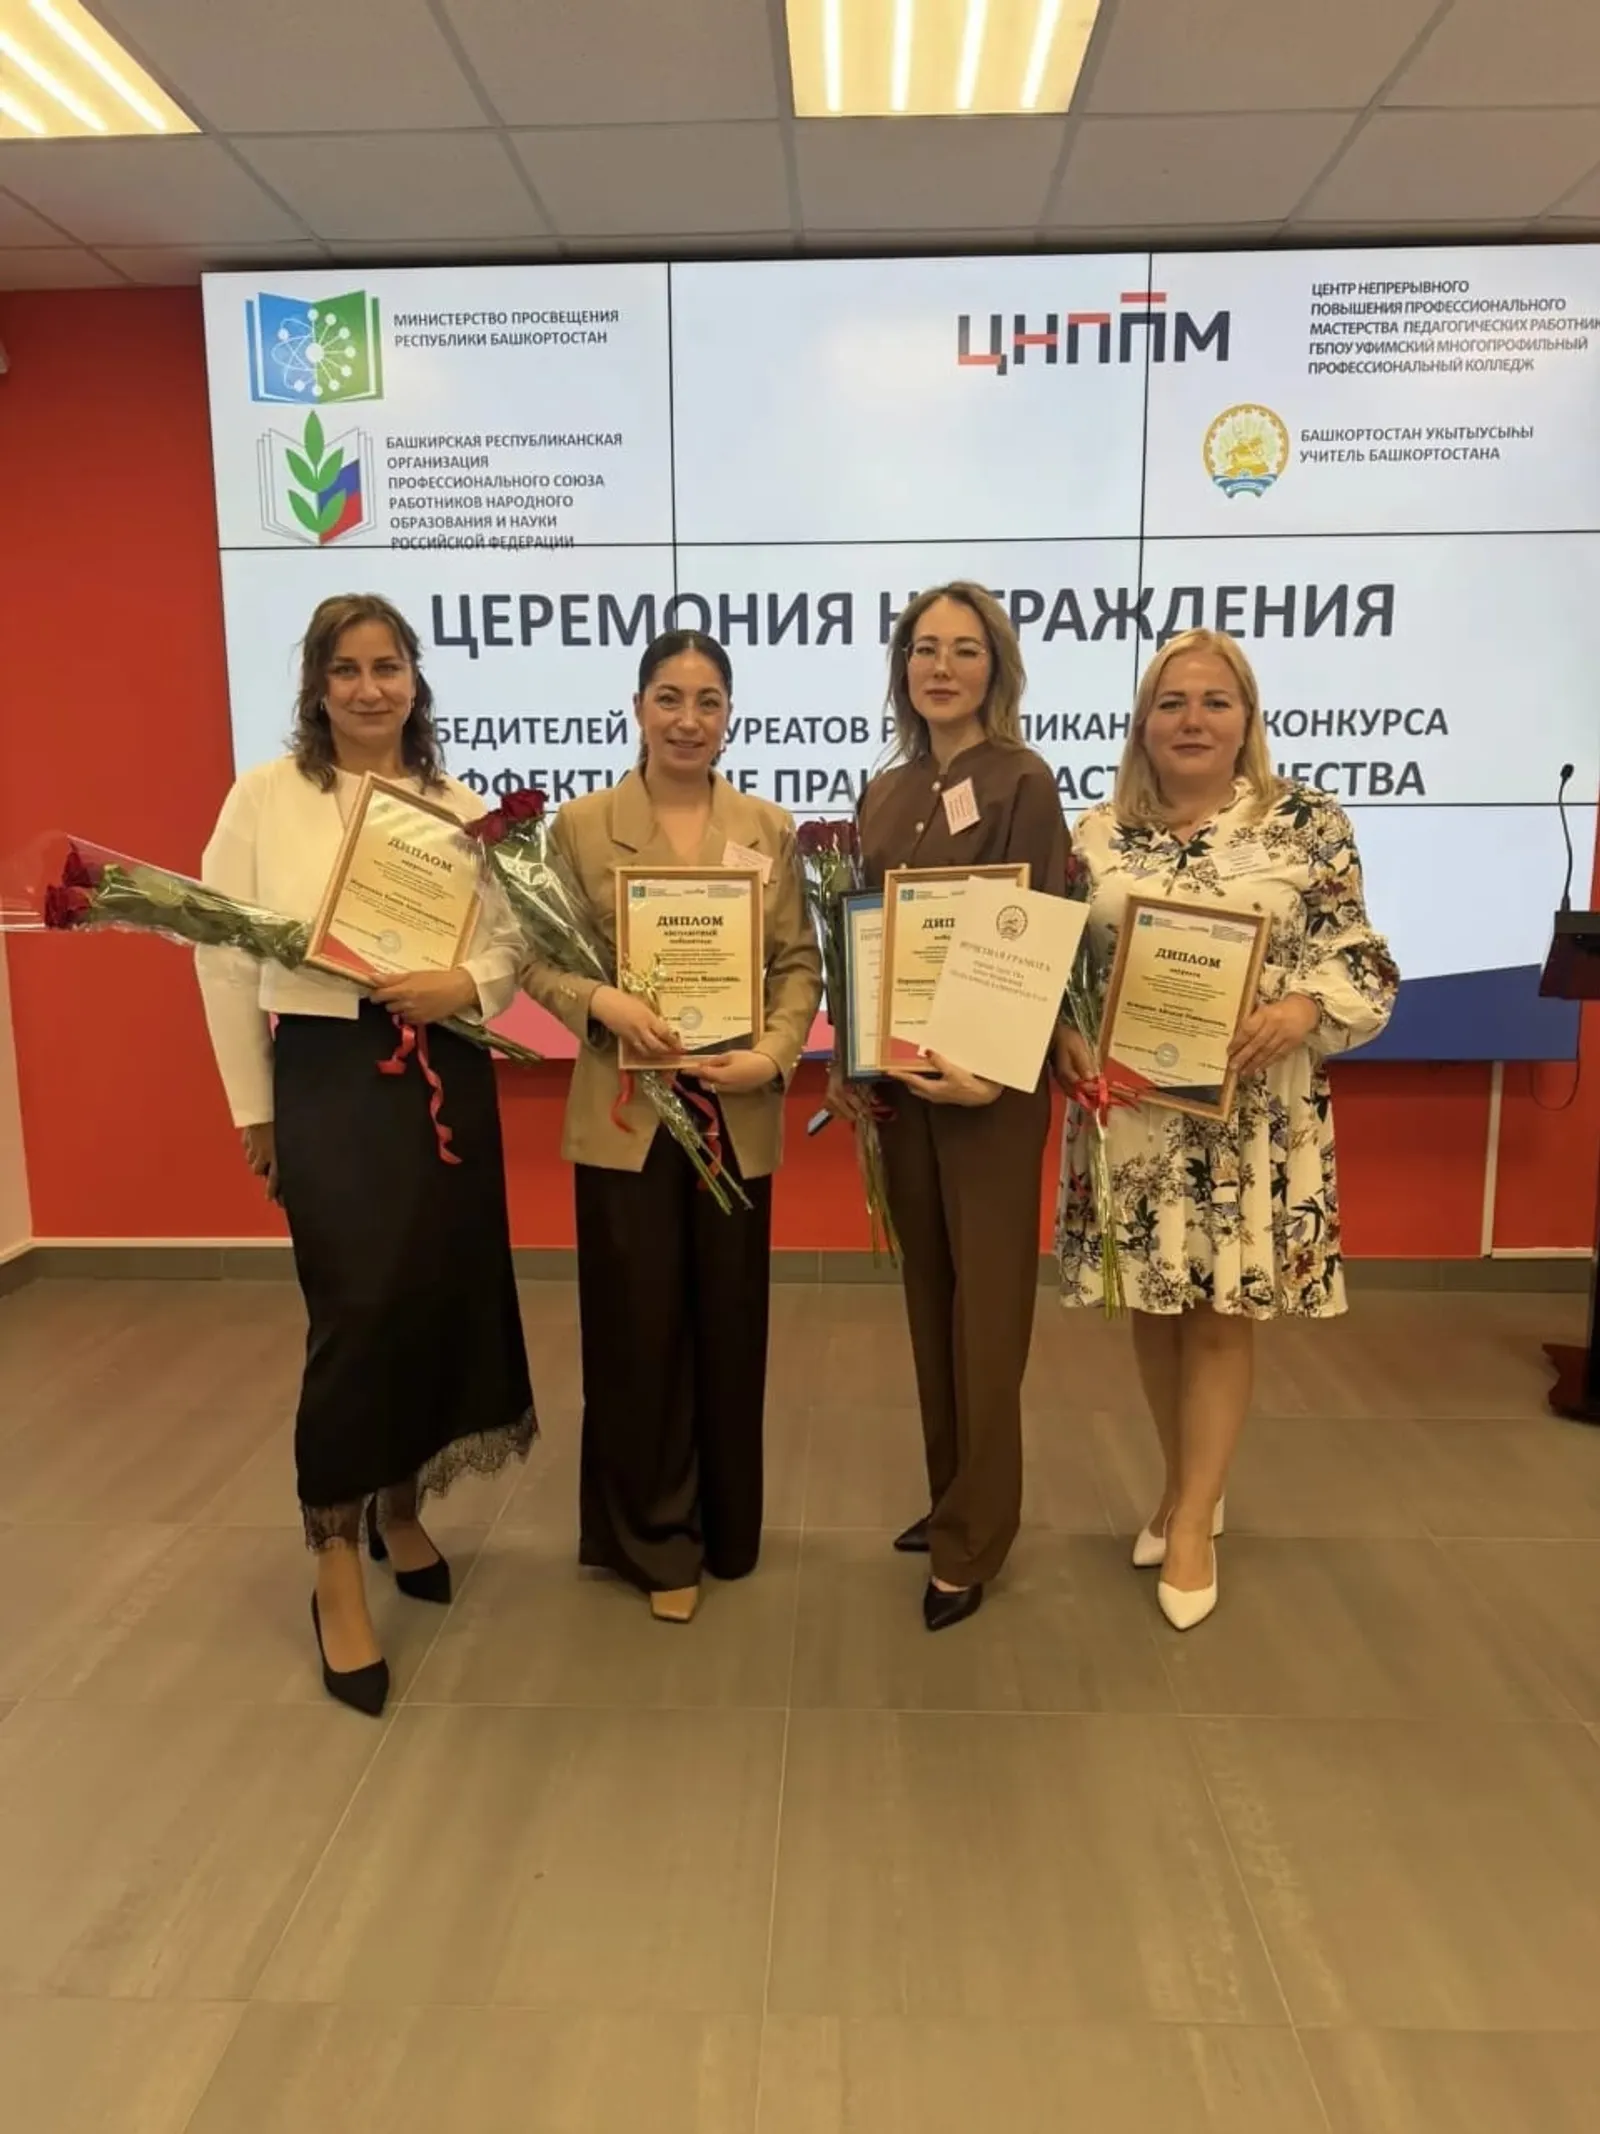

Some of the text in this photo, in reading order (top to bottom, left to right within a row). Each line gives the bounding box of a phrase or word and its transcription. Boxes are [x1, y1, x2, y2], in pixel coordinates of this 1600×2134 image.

[1312, 280, 1469, 297] ЦЕНТР НЕПРЕРЫВНОГО
[1311, 298, 1566, 316] ПОВЫШЕНИЯ ПРОФЕССИОНАЛЬНОГО
[394, 310, 619, 326] МИНИСТЕРСТВО ПРОСВЕЩЕНИЯ
[958, 292, 1230, 376] ЦНППМ
[1310, 321, 1398, 335] МАСТЕРСТВА
[1403, 318, 1528, 336] ПЕДАГОГИЧЕСКИХ
[395, 331, 607, 347] РЕСПУБЛИКИ БАШКОРТОСТАН
[1309, 336, 1588, 355] ГБПОУ УФИМСКИЙ МНОГОПРОФИЛЬНЫЙ
[1308, 357, 1534, 375] ПРОФЕССИОНАЛЬНЫЙ КОЛЛЕДЖ
[386, 433, 623, 449] БАШКИРСКАЯ РЕСПУБЛИКАНСКАЯ
[1301, 427, 1422, 442] БАШКОРТОСТАН
[387, 455, 489, 469] ОРГАНИЗАЦИЯ
[1300, 447, 1500, 464] УЧИТЕЛЬ БАШКОРТОСТАНА
[388, 474, 605, 489] ПРОФЕССИОНАЛЬНОГО СОЮЗА
[389, 495, 573, 509] РАБОТНИКОВ НАРОДНОГО
[390, 515, 557, 529] ОБРАЗОВАНИЯ И НАУКИ
[391, 534, 574, 551] РОССИЙСКОЙ ФЕДЕРАЦИИ
[431, 592, 853, 659] ЦЕРЕМОНИЯ
[1264, 707, 1449, 737] КОНКУРСА
[388, 836, 454, 873] ДИПЛОМ
[655, 915, 725, 927] ДИПЛОМ
[1154, 947, 1222, 969] ДИПЛОМ
